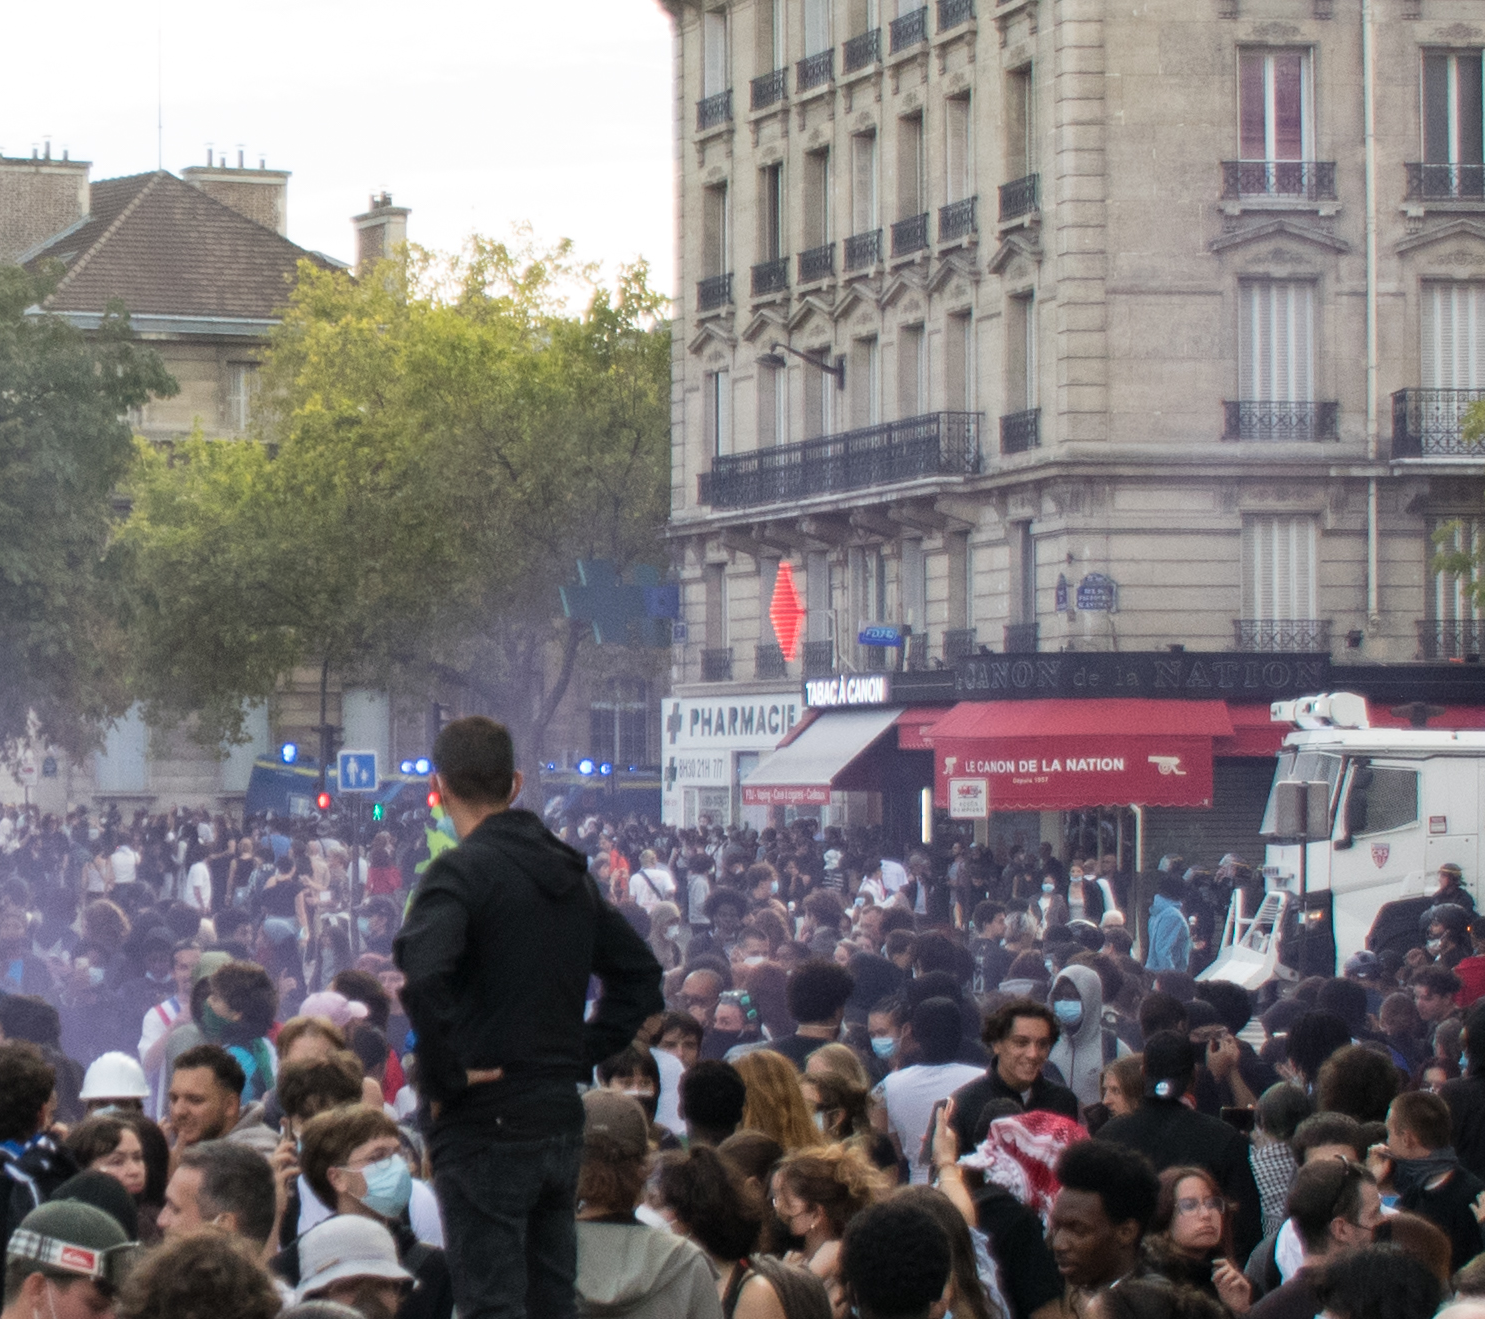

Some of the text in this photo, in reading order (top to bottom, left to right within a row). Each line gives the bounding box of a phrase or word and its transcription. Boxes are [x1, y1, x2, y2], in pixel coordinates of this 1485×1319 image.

[1153, 660, 1324, 689] NATION
[806, 680, 838, 706] TABAC
[847, 677, 884, 704] CANON
[689, 703, 795, 737] PHARMACIE
[965, 757, 1125, 773] LE CANON DE LA NATION
